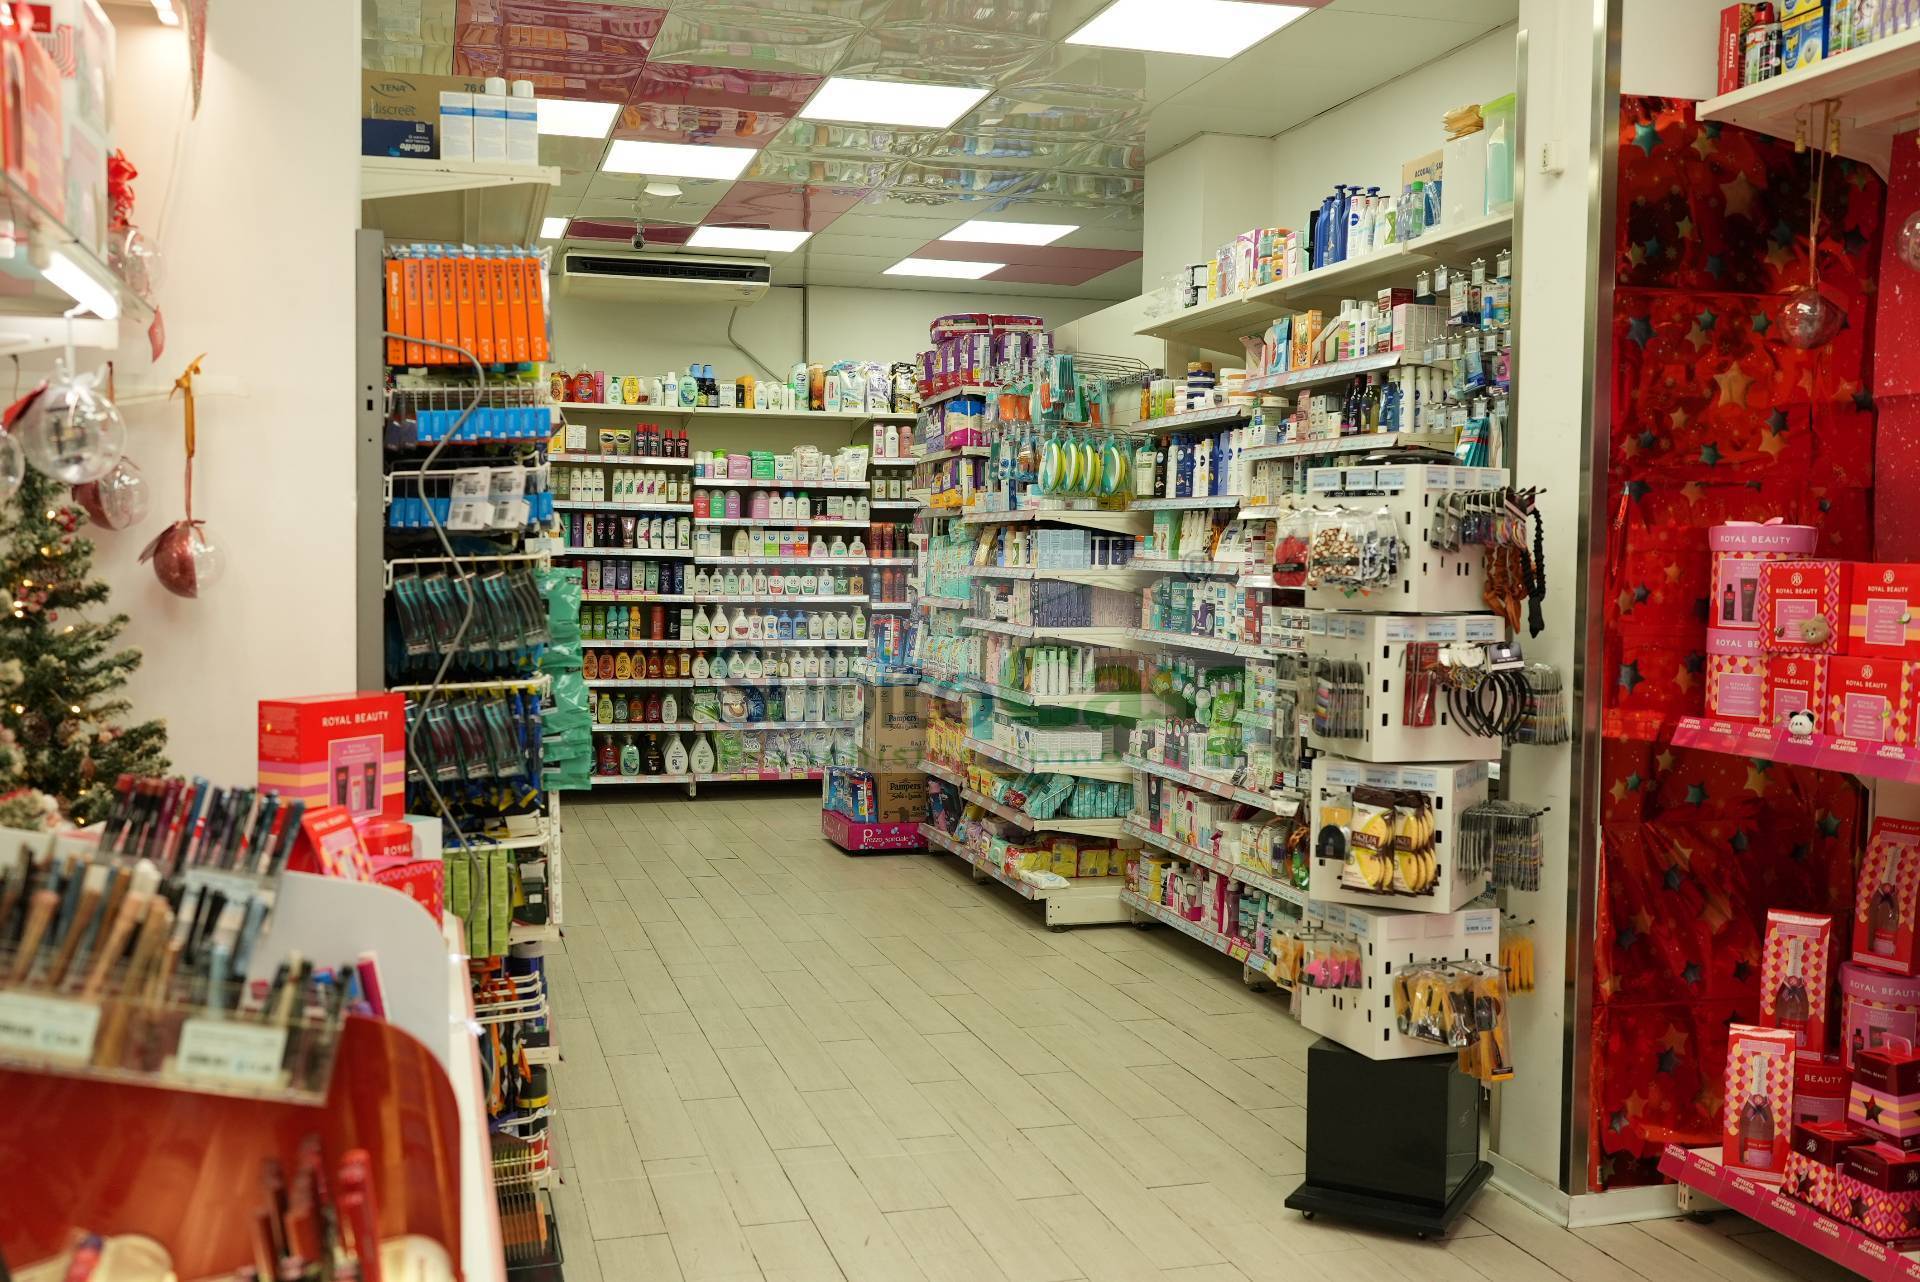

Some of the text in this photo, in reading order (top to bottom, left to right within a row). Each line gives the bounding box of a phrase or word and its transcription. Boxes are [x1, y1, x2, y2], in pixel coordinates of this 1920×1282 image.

[380, 83, 406, 92] TENA
[464, 83, 477, 92] 76
[399, 143, 431, 153] Gillette
[1720, 535, 1791, 545] ROYAL BEAUTY
[1775, 587, 1794, 595] ROYAL
[1716, 639, 1742, 648] ROYAL
[1790, 678, 1809, 686] BEAUTY
[1845, 679, 1888, 689] ROYAL BEAUTY
[322, 710, 389, 728] ROYAL BEAUTY
[888, 714, 917, 723] Pampers
[889, 782, 921, 791] Pampers
[383, 846, 411, 856] ROYAL
[1849, 980, 1876, 993] ROYAL
[1804, 1074, 1843, 1084] BEAUTY
[1693, 1162, 1717, 1177] VOLANTINO
[1698, 1158, 1716, 1171] OFFERTA
[1735, 1176, 1755, 1190] OFFERTA
[1731, 1181, 1756, 1197] VOLANTINO
[1775, 1196, 1796, 1210] OFFERTA
[1771, 1201, 1797, 1217] VOLANTINO
[1818, 1216, 1839, 1231] OFFERTA
[1813, 1221, 1840, 1239] VOLANTINO
[1863, 1239, 1885, 1254] OFFERTA
[1858, 1244, 1887, 1262] VOLANTINO
